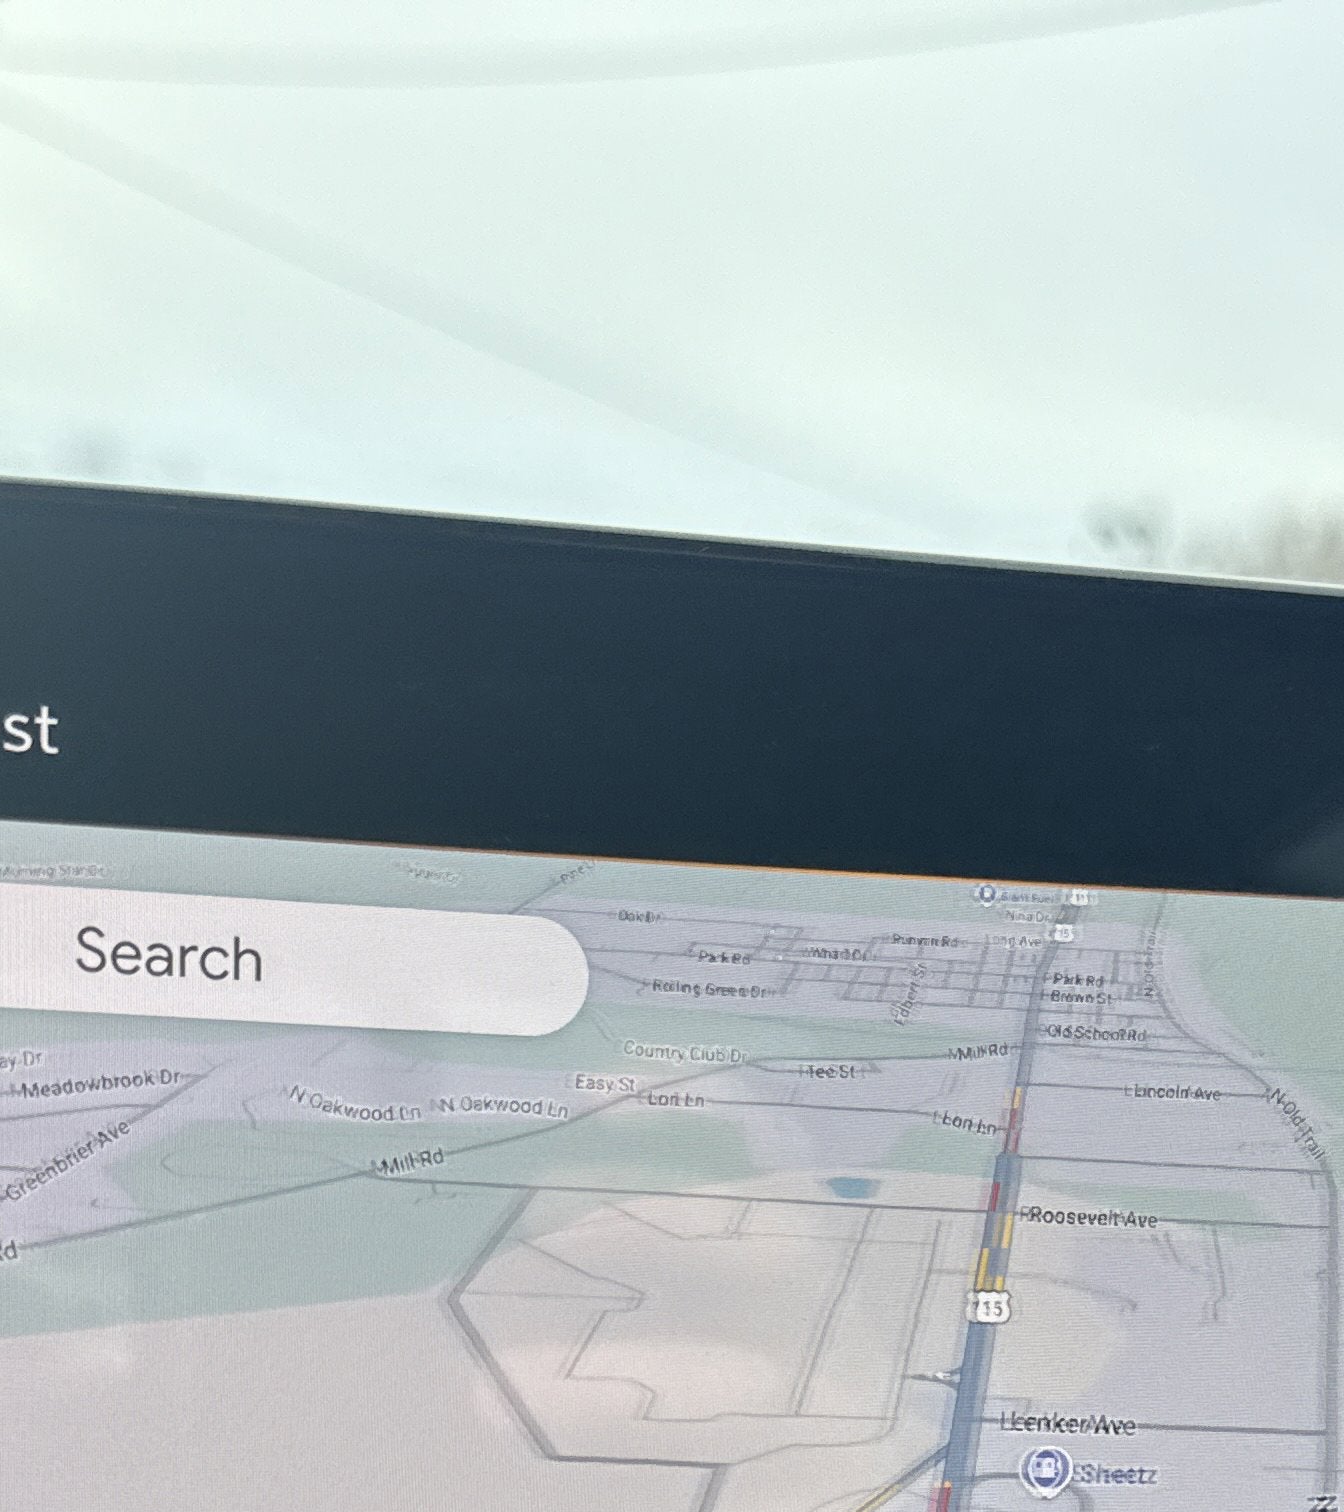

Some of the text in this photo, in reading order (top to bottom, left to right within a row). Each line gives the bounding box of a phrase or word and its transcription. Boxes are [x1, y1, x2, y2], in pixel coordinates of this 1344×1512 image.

[76, 926, 261, 981] Search
[1050, 989, 1113, 1005] Brown St
[1126, 1028, 1147, 1042] Rd
[22, 1050, 43, 1067] Dr
[20, 1068, 181, 1099] Meadowbrook Dr
[575, 1073, 636, 1093] Easy St
[1193, 1086, 1222, 1101] Ave
[289, 1084, 305, 1103] N
[309, 1093, 394, 1122] Oakwood
[438, 1095, 569, 1119] N Oakwood Ln
[1270, 1087, 1326, 1160] N Old Trail
[3, 1120, 131, 1202] Greenbrier Ave
[420, 1148, 445, 1167] Rd
[1024, 1206, 1159, 1229] Roosevelt Ave
[1088, 1414, 1137, 1437] Ave
[1074, 1463, 1158, 1485] Sheetz
